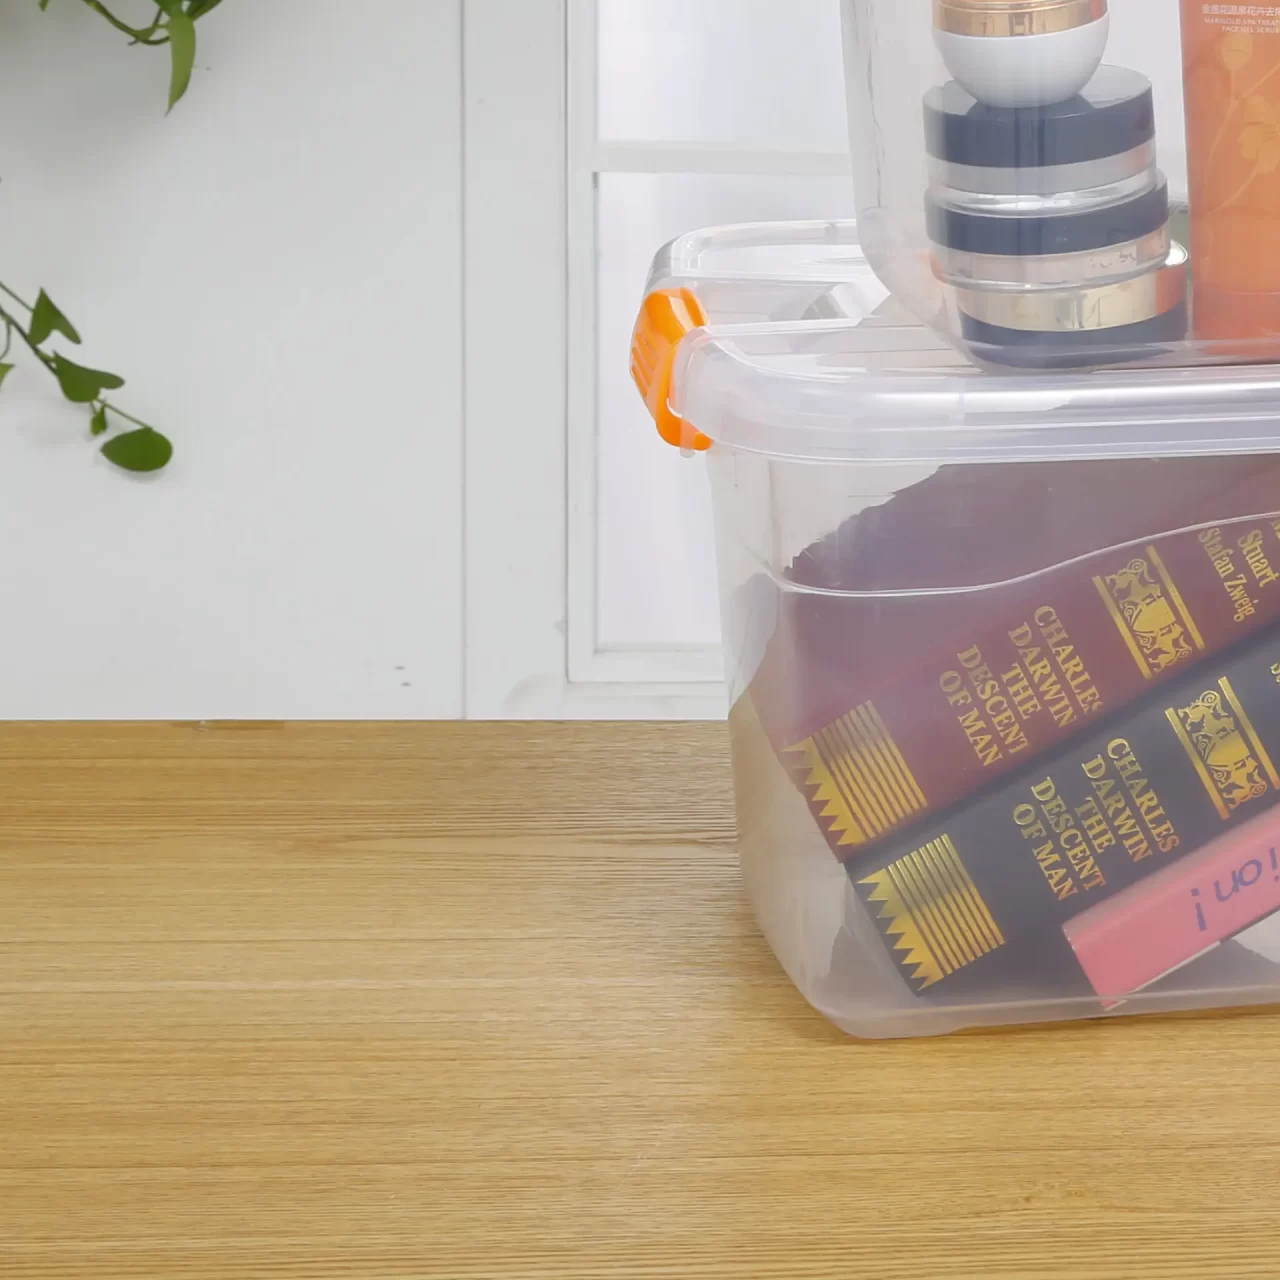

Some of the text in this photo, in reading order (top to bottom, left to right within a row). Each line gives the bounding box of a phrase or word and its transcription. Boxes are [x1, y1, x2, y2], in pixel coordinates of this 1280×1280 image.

[1199, 527, 1259, 623] Stafan Zweig
[1237, 529, 1280, 588] Stuart
[939, 670, 1003, 767] OF MAN
[956, 643, 1029, 754] DESCENT
[1001, 662, 1042, 720] THE
[1007, 621, 1077, 728] DARWIN
[1031, 776, 1106, 891] DESCENT
[1074, 795, 1117, 854] THE
[1082, 754, 1153, 863] DARWIN
[1107, 738, 1180, 852] CHARLES
[1013, 803, 1078, 901] OF MAN
